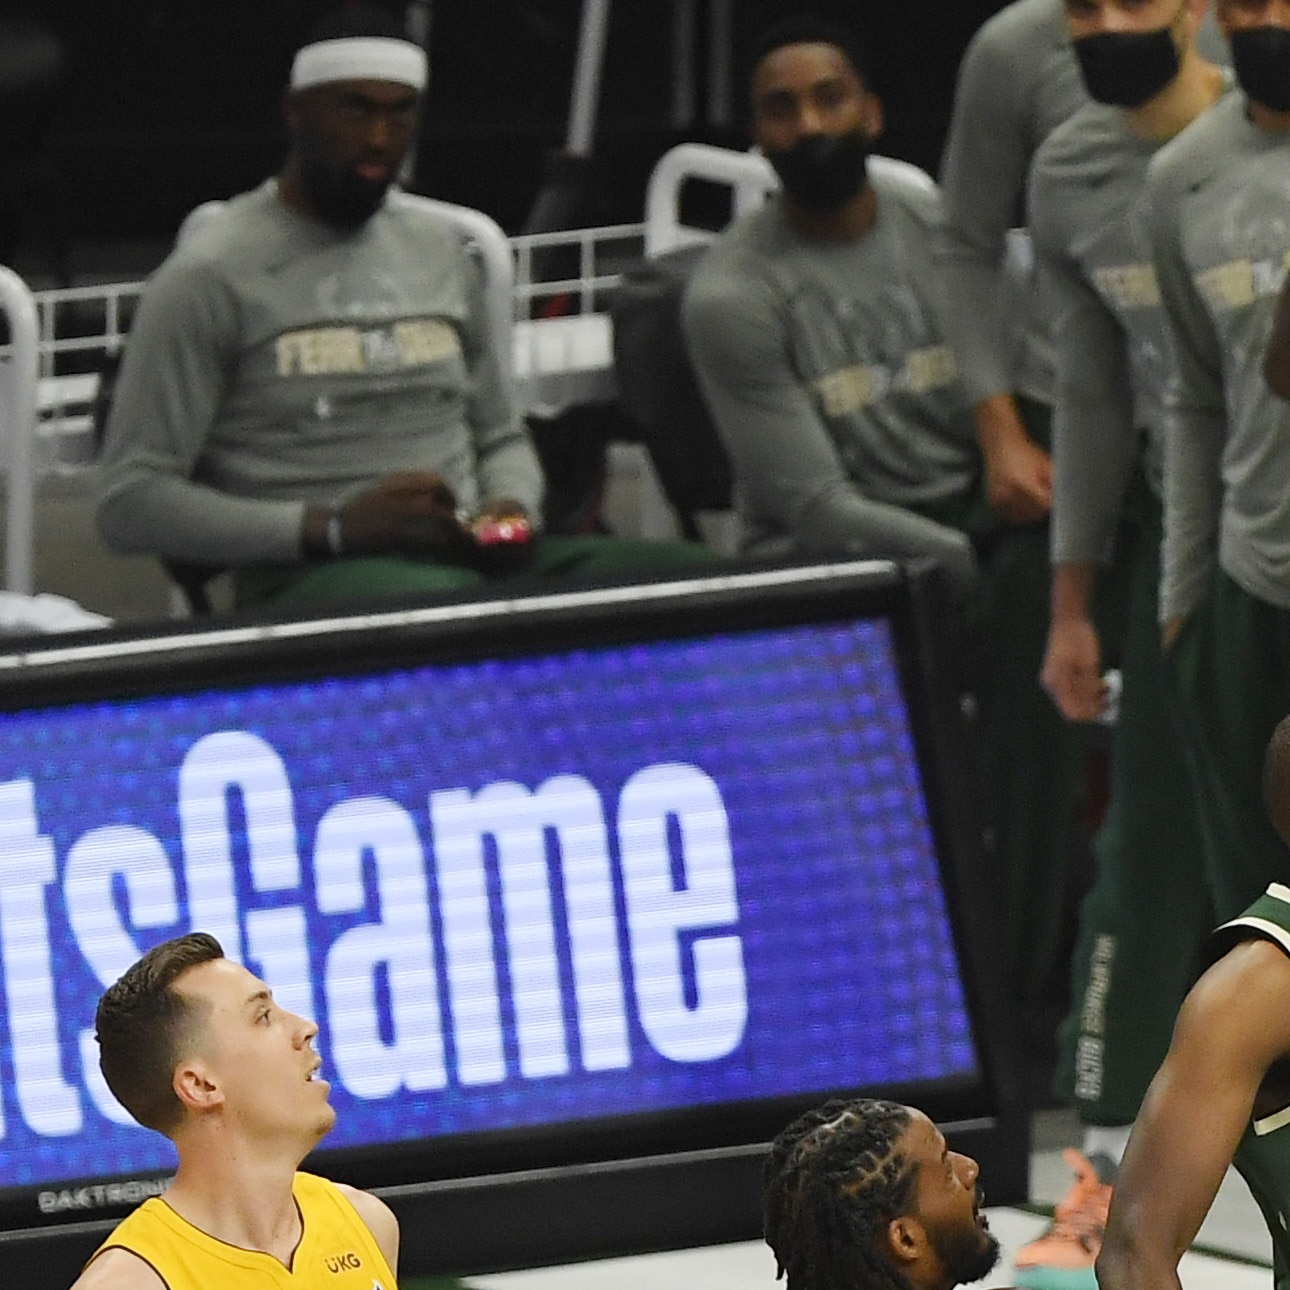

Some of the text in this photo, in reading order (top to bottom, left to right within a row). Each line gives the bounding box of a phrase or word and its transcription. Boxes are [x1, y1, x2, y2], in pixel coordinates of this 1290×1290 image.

[0, 729, 749, 1137] tsGame
[37, 1177, 175, 1214] DAKTRON
[324, 1253, 361, 1274] UKG
